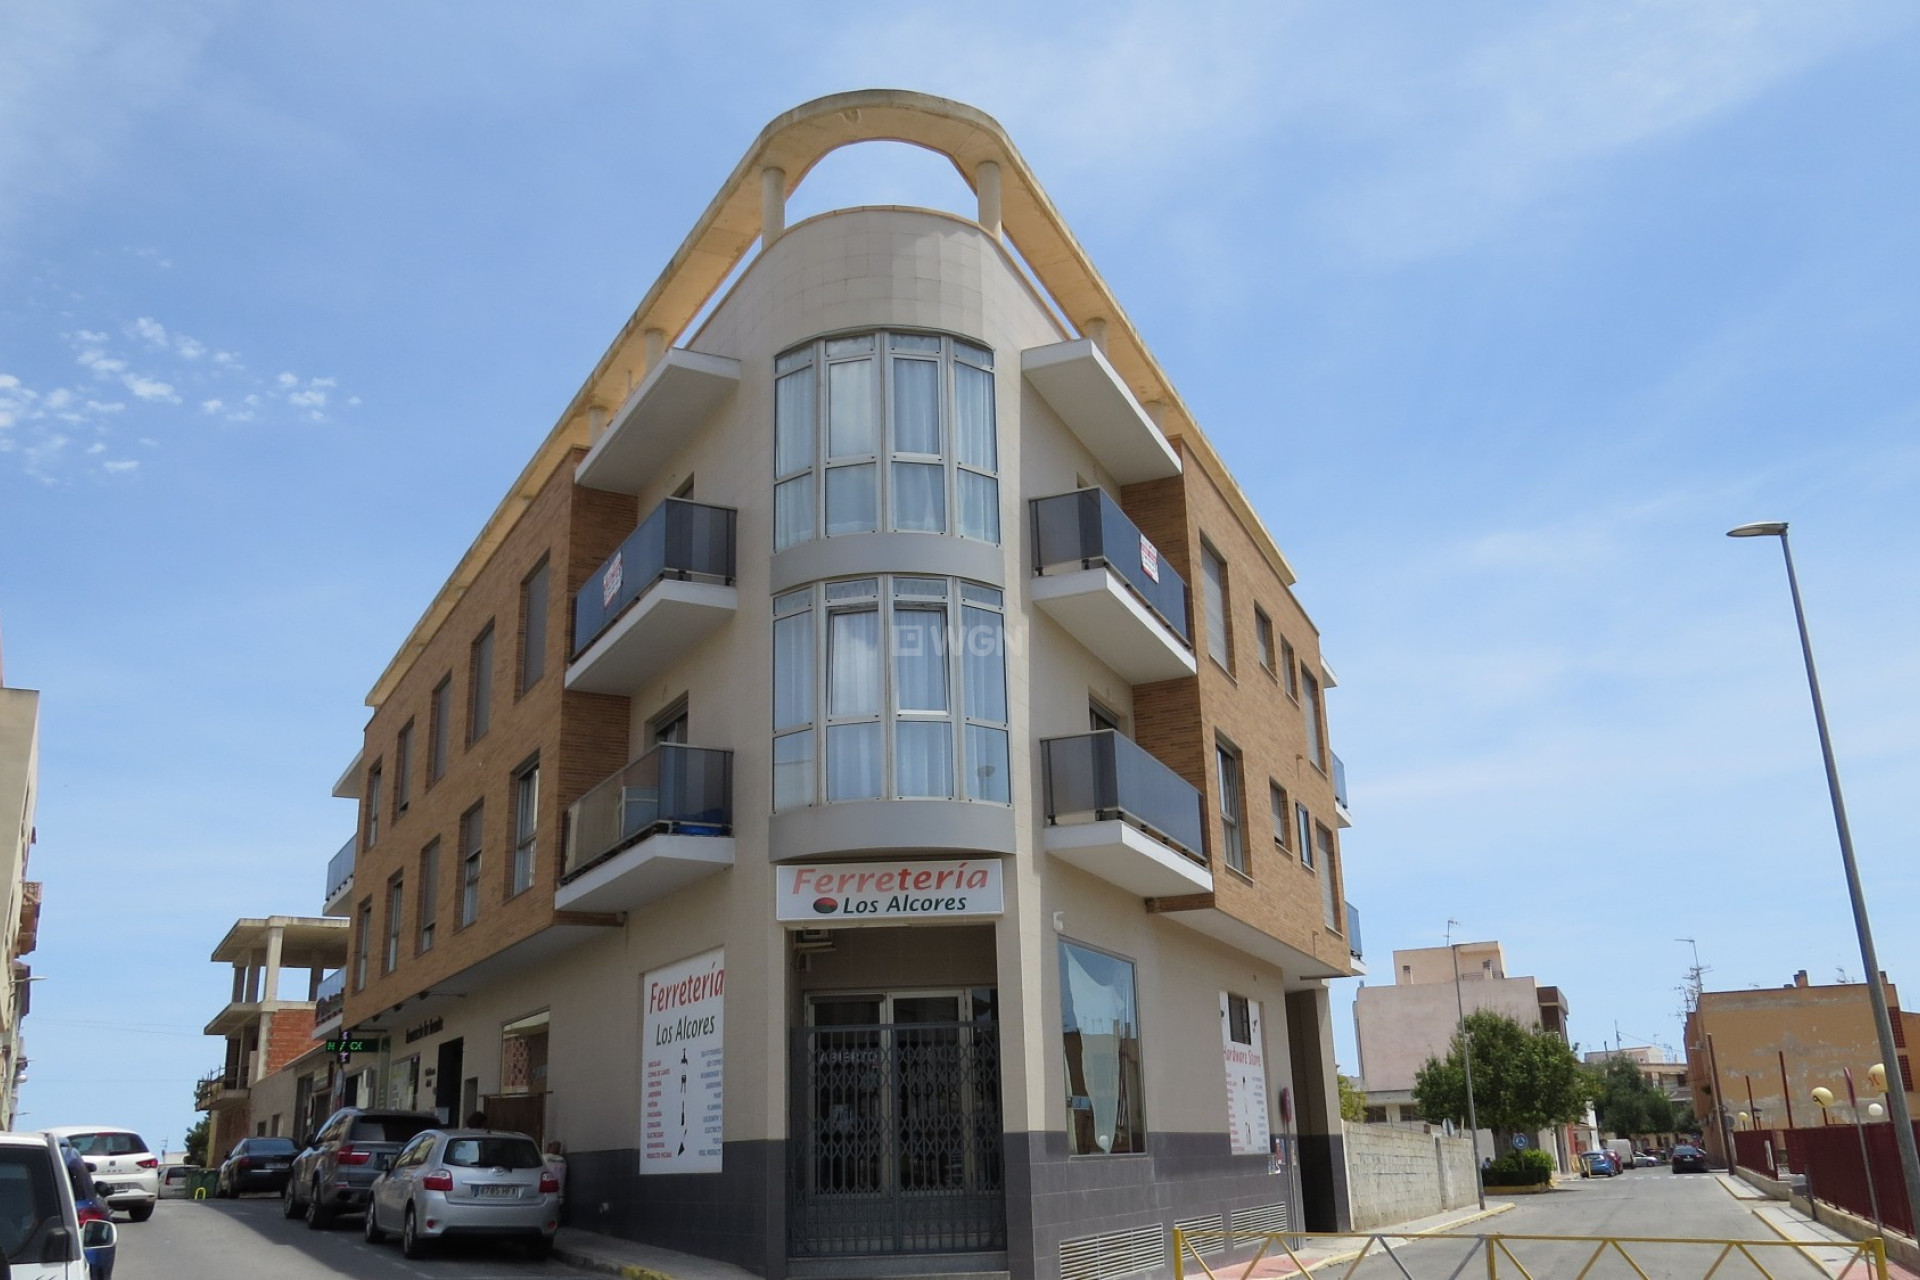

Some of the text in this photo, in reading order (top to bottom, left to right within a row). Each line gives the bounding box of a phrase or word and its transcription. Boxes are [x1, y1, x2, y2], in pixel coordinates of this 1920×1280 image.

[792, 862, 989, 895] Ferretería
[843, 894, 967, 914] Los Alcores
[649, 961, 725, 1014] Ferretería
[656, 1015, 715, 1046] Los Alcores
